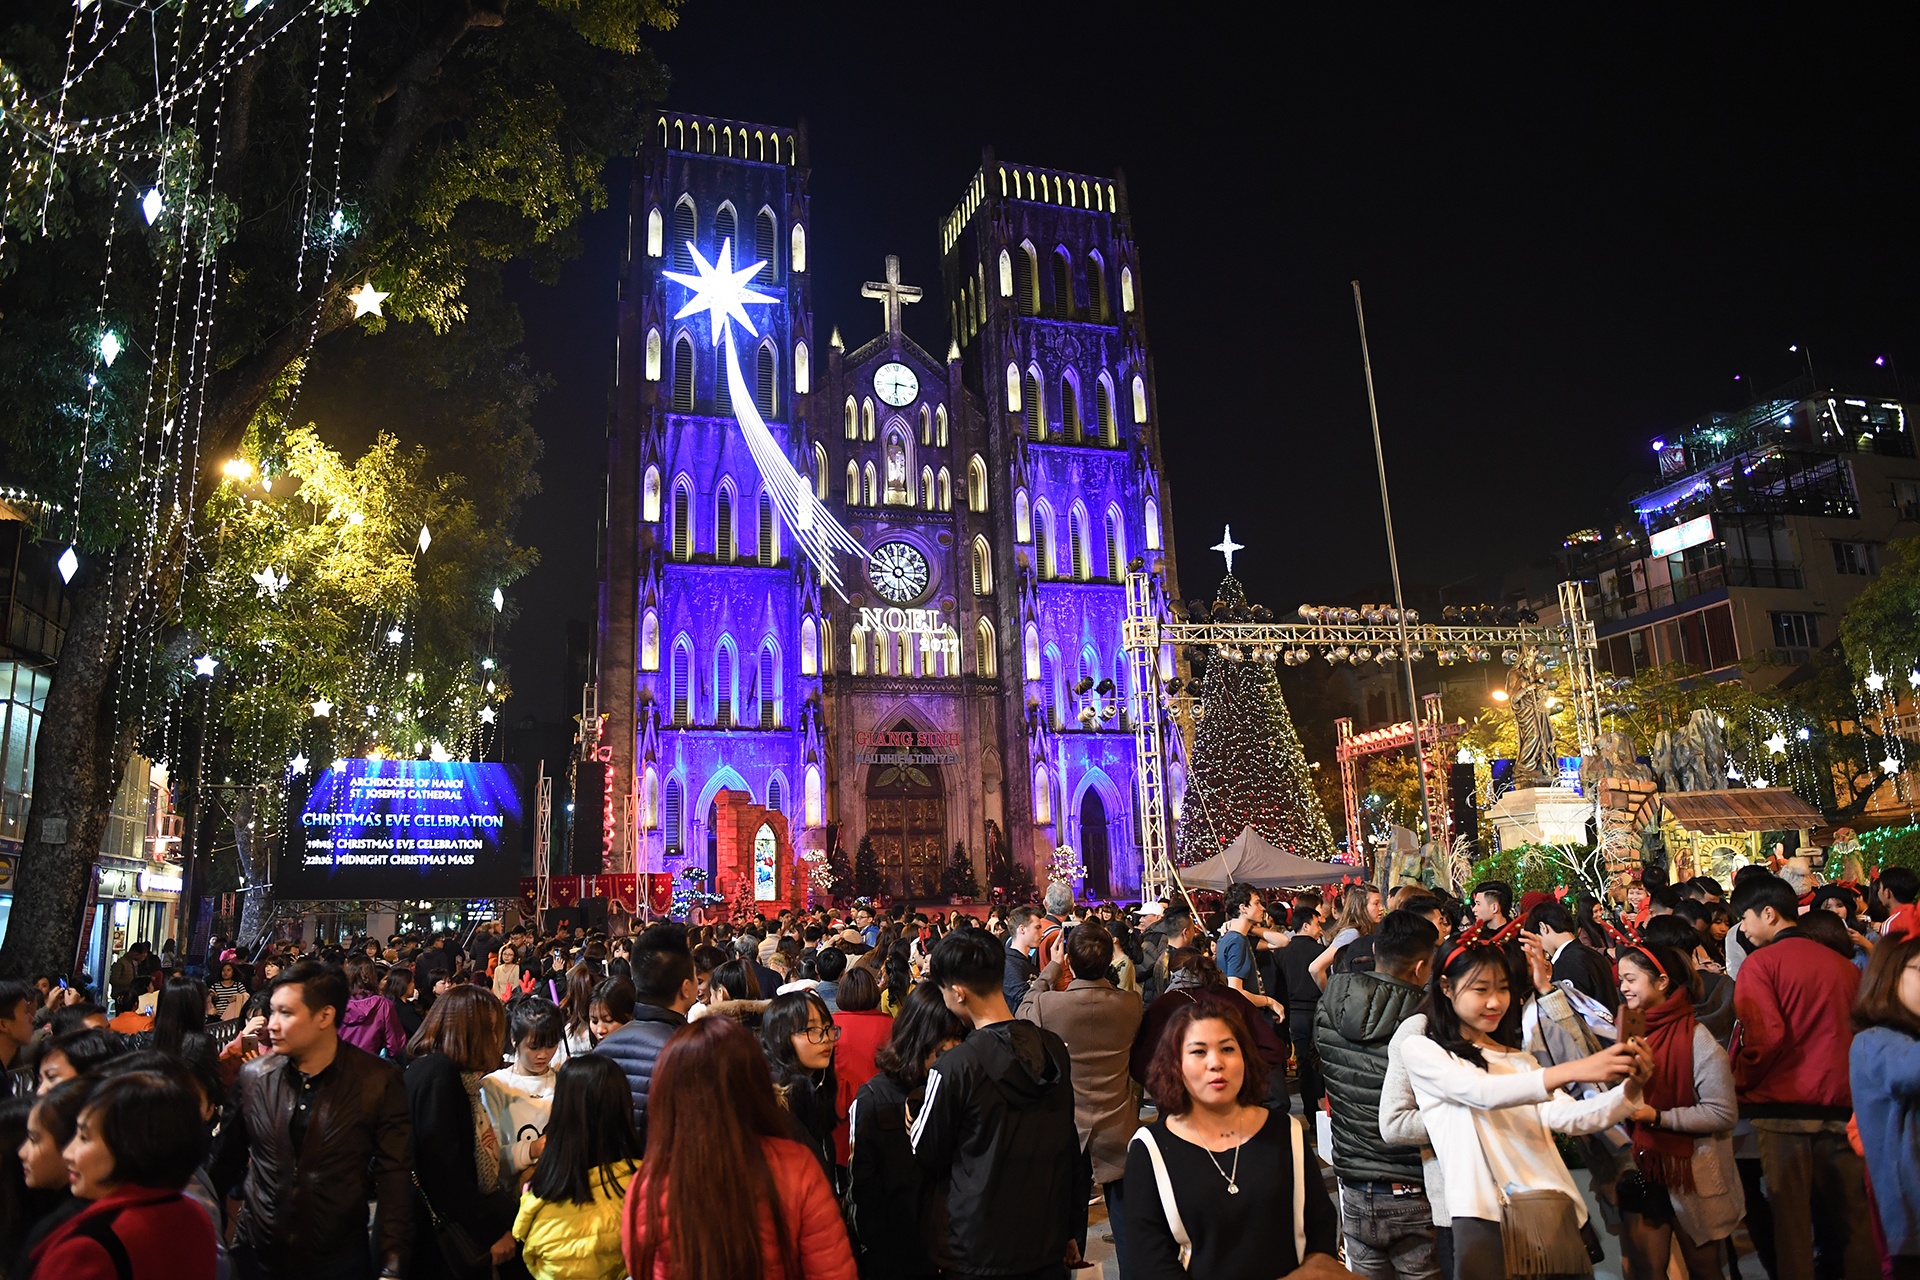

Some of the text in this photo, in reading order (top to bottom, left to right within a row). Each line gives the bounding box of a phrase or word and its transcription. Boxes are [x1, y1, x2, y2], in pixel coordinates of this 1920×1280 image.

[859, 607, 947, 634] NOEL
[919, 637, 959, 652] 2017
[917, 731, 960, 747] SINH
[350, 777, 464, 789] ARCHDIOCESE OF HANOI
[350, 788, 364, 798] ST.
[407, 790, 462, 800] CATHEDRAL
[302, 812, 503, 827] CHRISTMAS EVE CELEBRATION
[336, 839, 394, 849] CHRISTMAS
[396, 839, 415, 849] EVE
[417, 839, 483, 849] CELEBRATION
[336, 854, 389, 865] MIDNIGHT
[390, 854, 446, 865] CHRISTMAS
[448, 854, 475, 865] MASS
